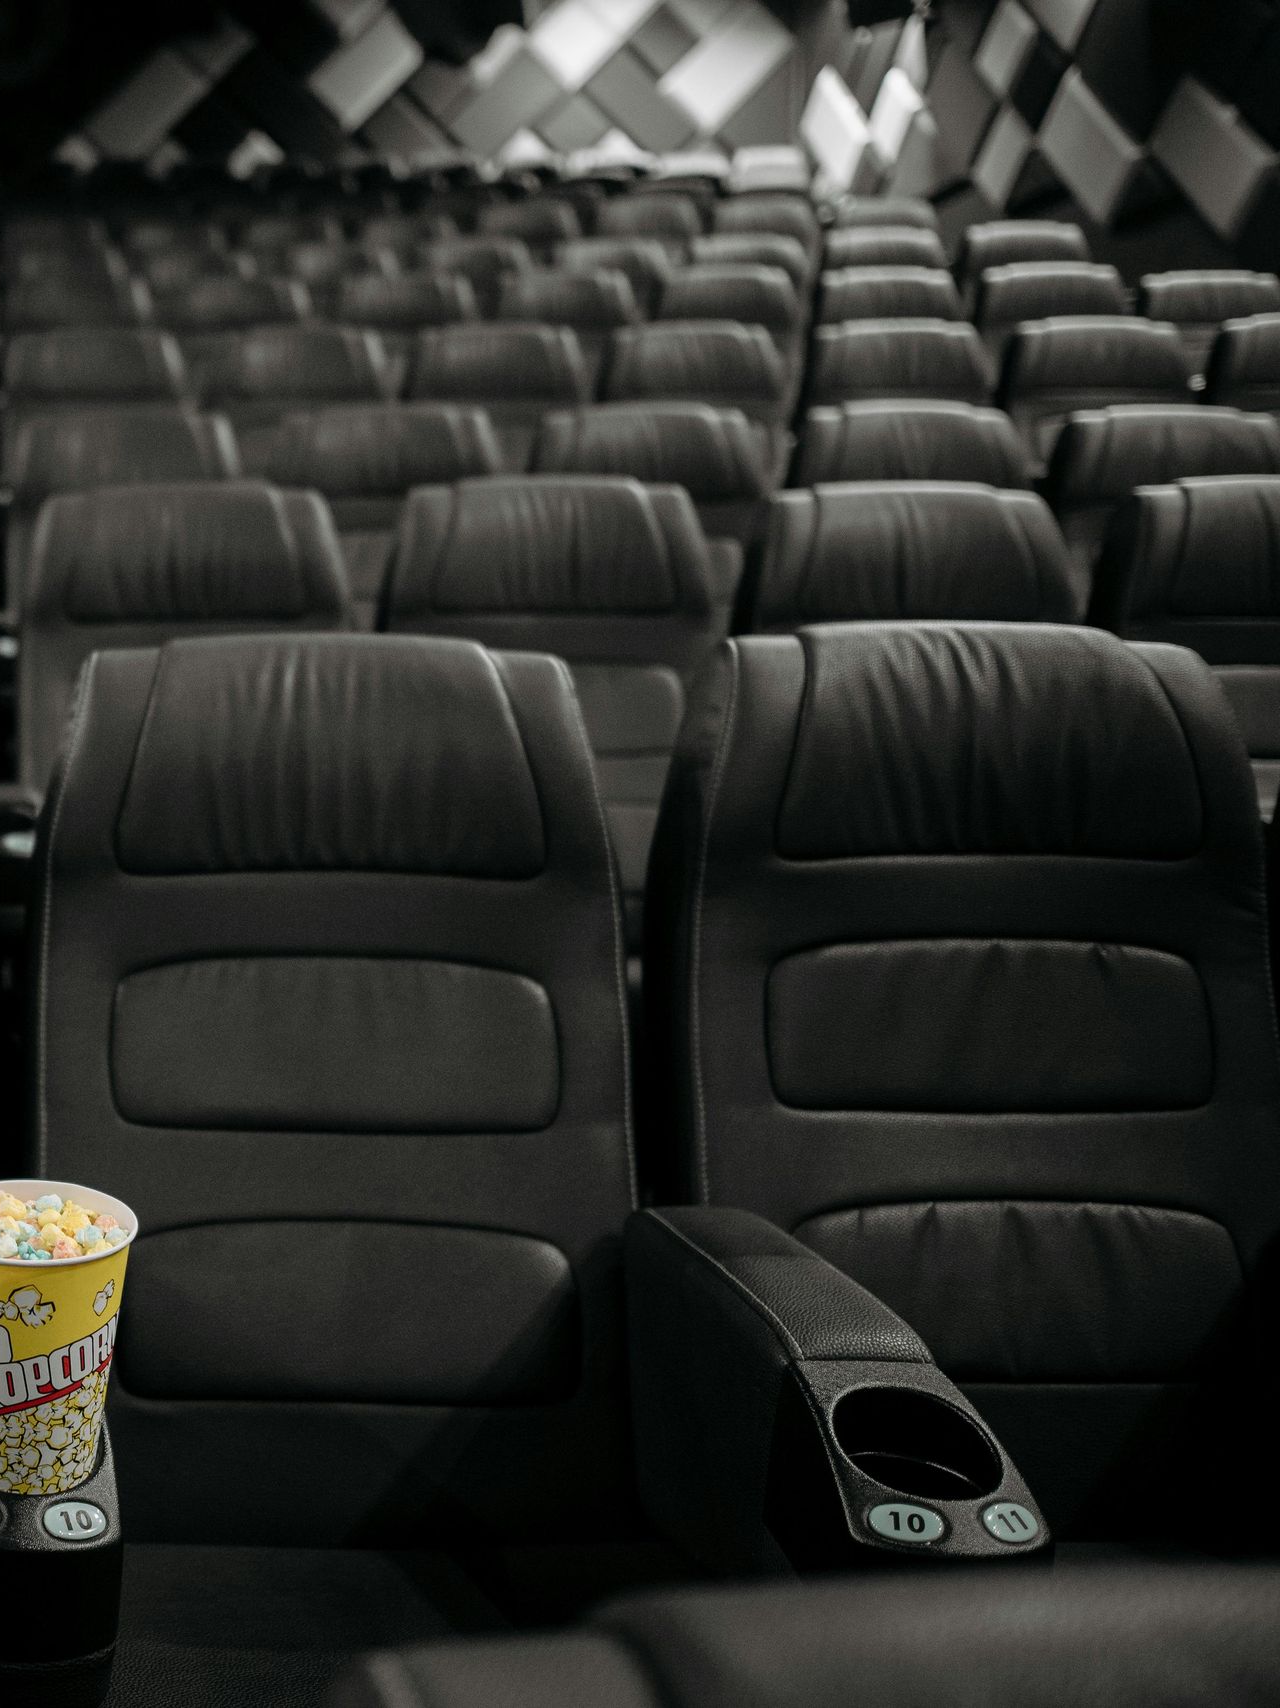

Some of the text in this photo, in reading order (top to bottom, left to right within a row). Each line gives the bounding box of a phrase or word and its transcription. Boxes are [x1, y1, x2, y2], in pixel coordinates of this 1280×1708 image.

[59, 1509, 93, 1531] 10
[888, 1510, 926, 1534] 10
[997, 1510, 1029, 1534] 11
